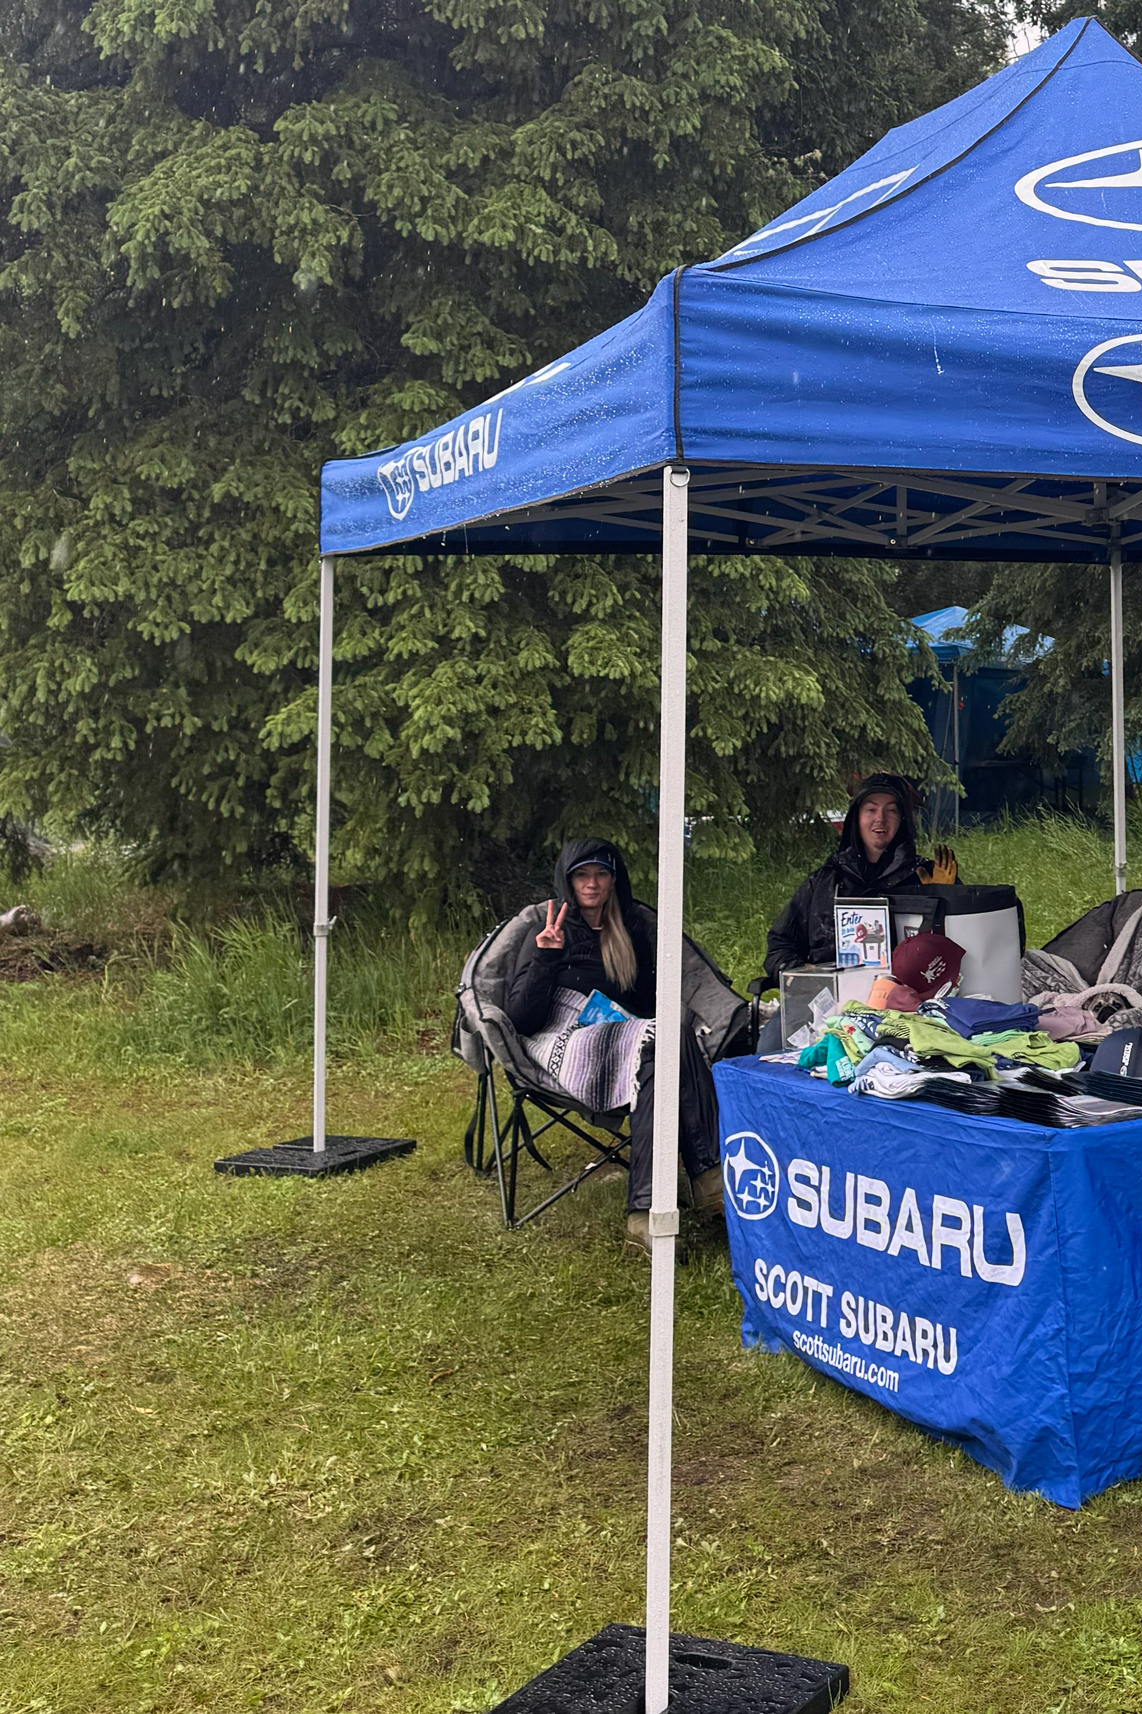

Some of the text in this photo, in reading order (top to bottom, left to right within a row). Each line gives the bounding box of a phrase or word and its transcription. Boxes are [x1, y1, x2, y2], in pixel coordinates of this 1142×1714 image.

[413, 408, 503, 491] SUBARU
[841, 911, 863, 927] Enter
[786, 1158, 1027, 1287] SUBARU
[754, 1258, 958, 1375] SCOTT SUBARU
[792, 1330, 899, 1393] scottsubaru.com
